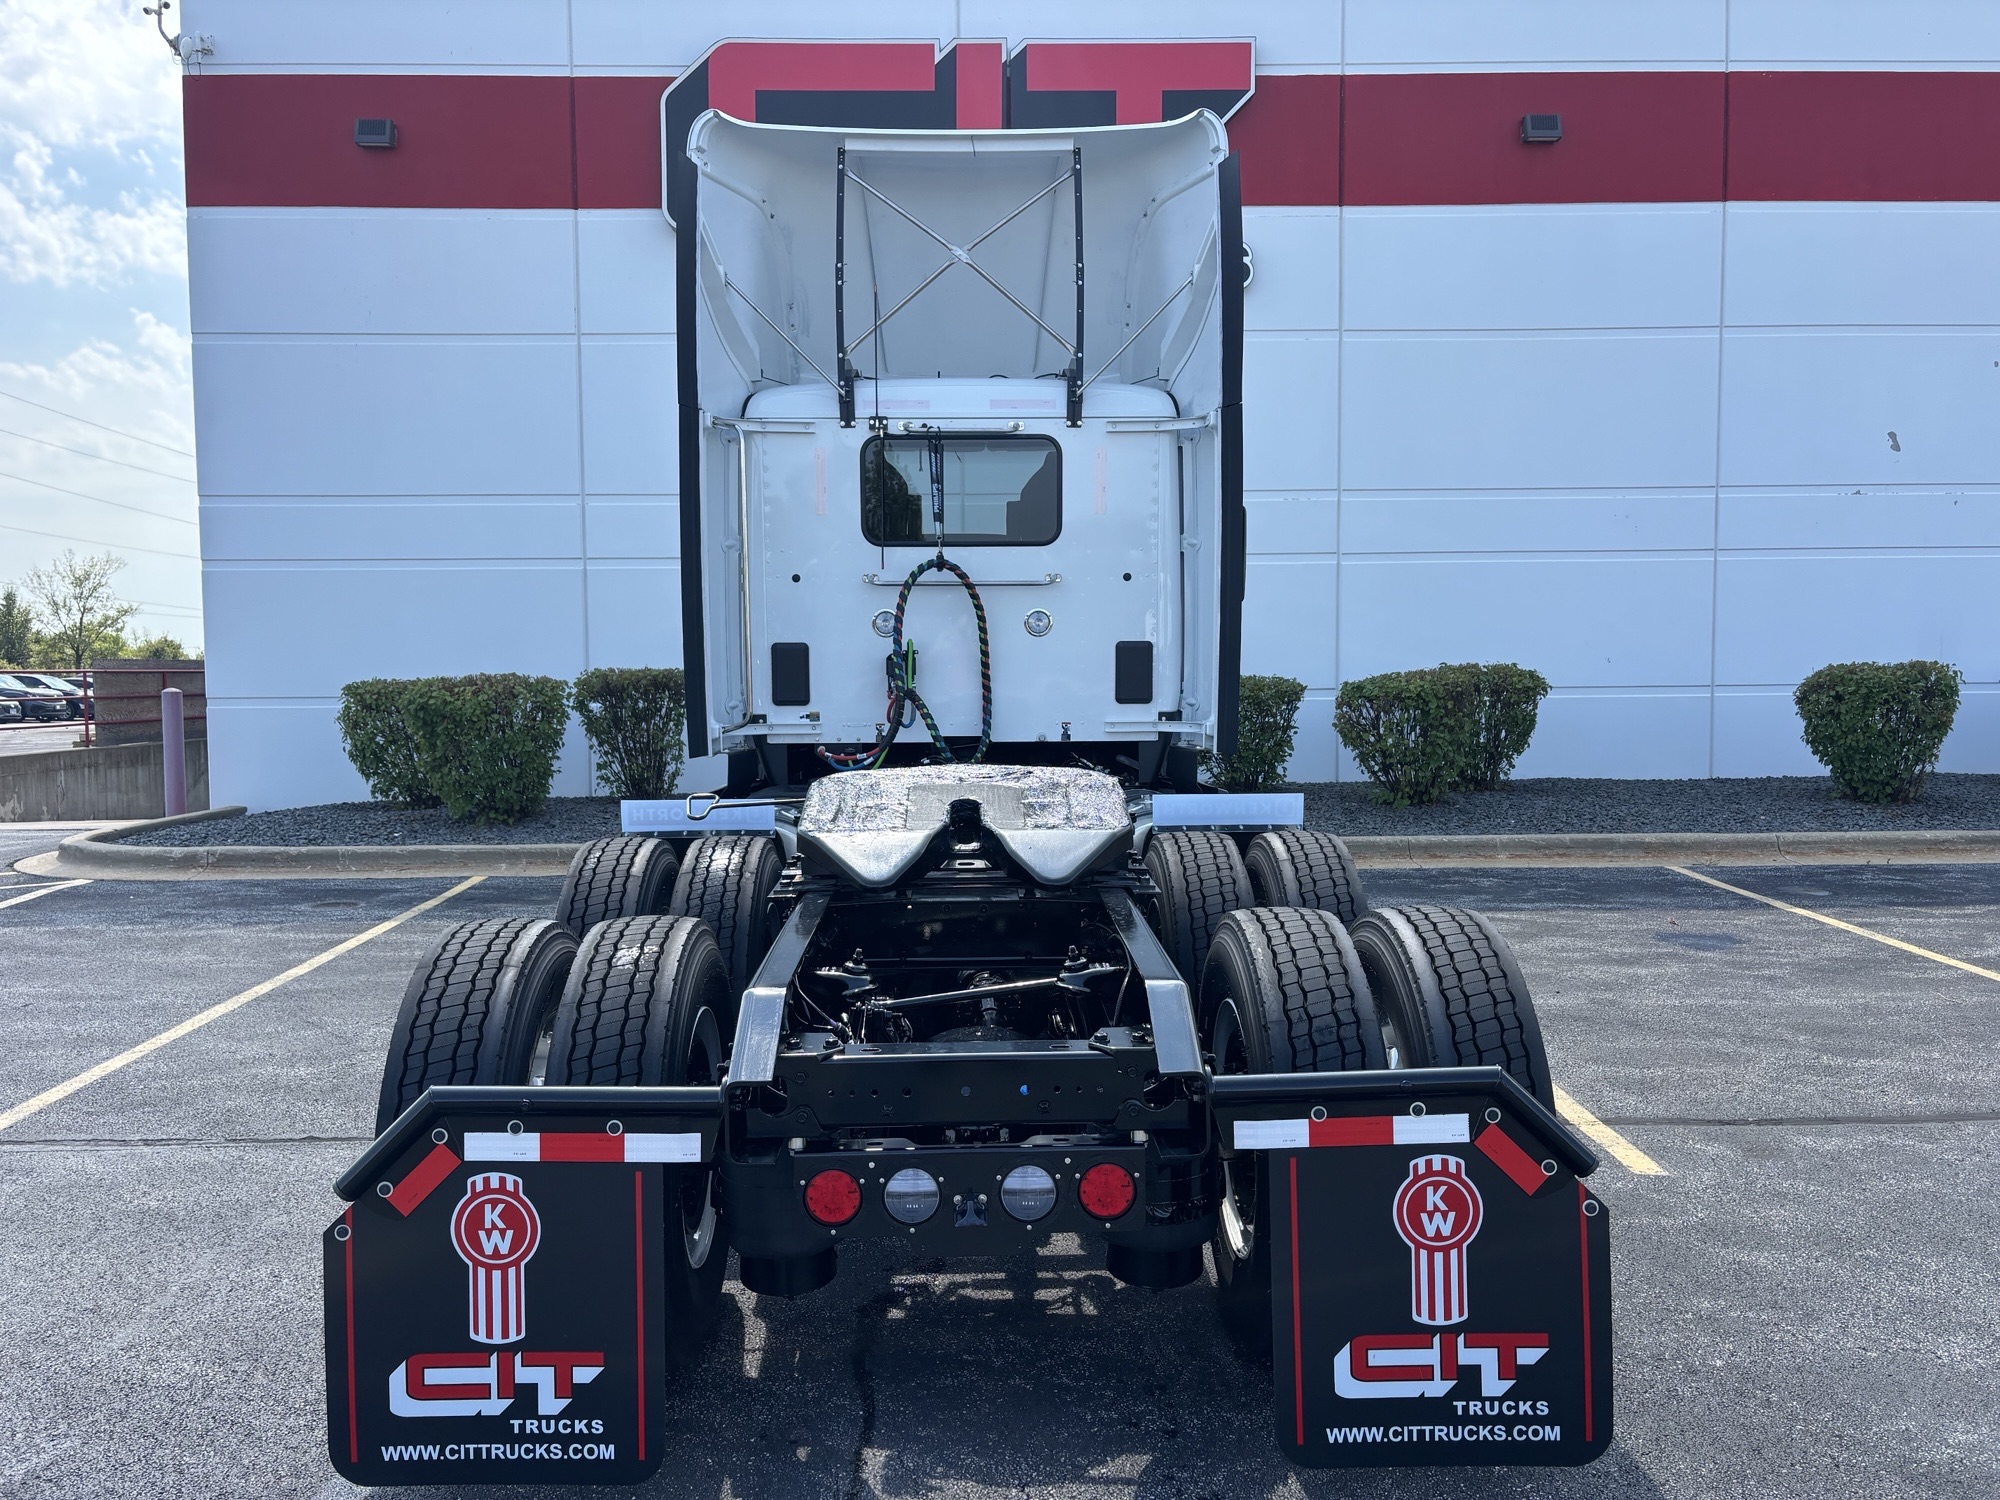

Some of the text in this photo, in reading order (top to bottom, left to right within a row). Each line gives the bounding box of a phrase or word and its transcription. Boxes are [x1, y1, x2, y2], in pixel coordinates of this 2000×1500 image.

[1334, 1332, 1550, 1399] CIT
[389, 1351, 605, 1417] CIT
[1453, 1400, 1549, 1416] TRUCKS
[510, 1419, 604, 1434] TRUCKS
[1326, 1425, 1561, 1443] WWW.CITTRUCKS.COM
[381, 1443, 615, 1461] WWW.CITTRUCKS.COM
